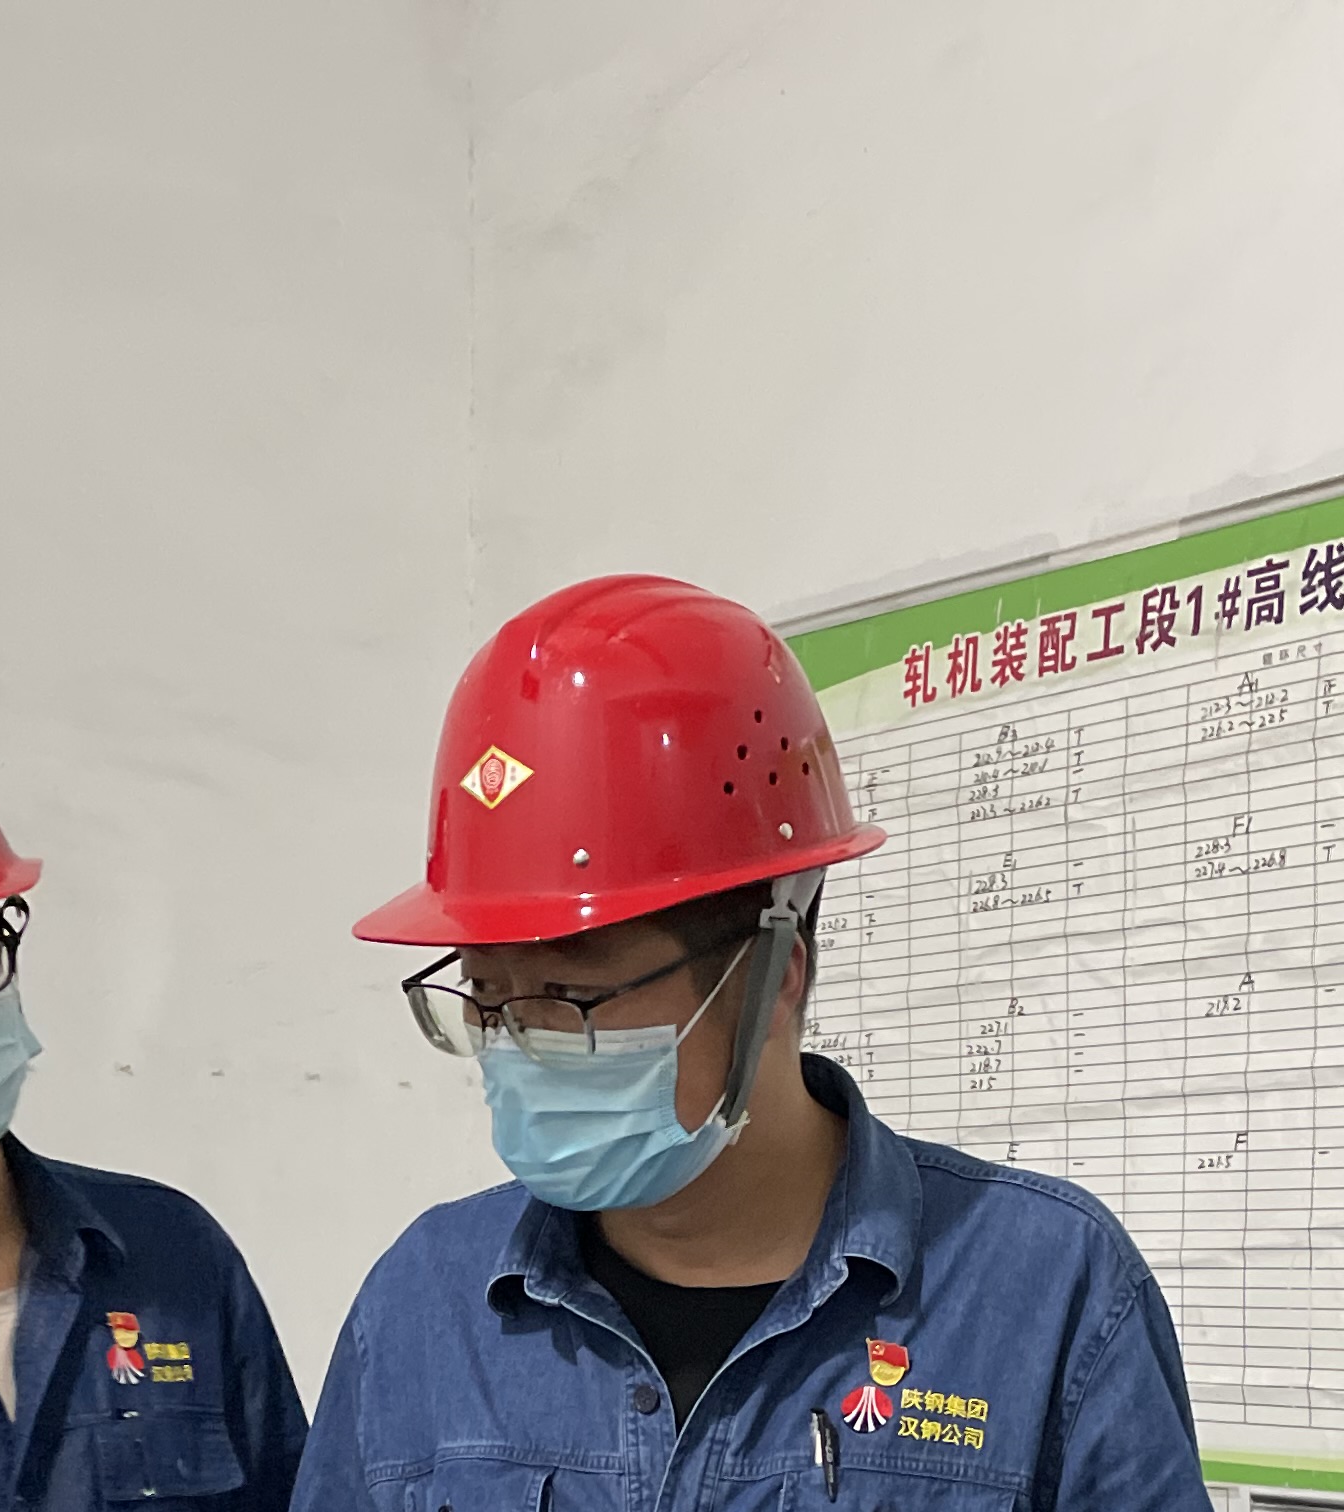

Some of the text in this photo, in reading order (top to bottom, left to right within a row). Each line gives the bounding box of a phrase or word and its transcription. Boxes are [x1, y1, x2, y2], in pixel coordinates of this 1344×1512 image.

[899, 1386, 990, 1423] 陕钢集团
[896, 1415, 985, 1450] 汉钢公司
